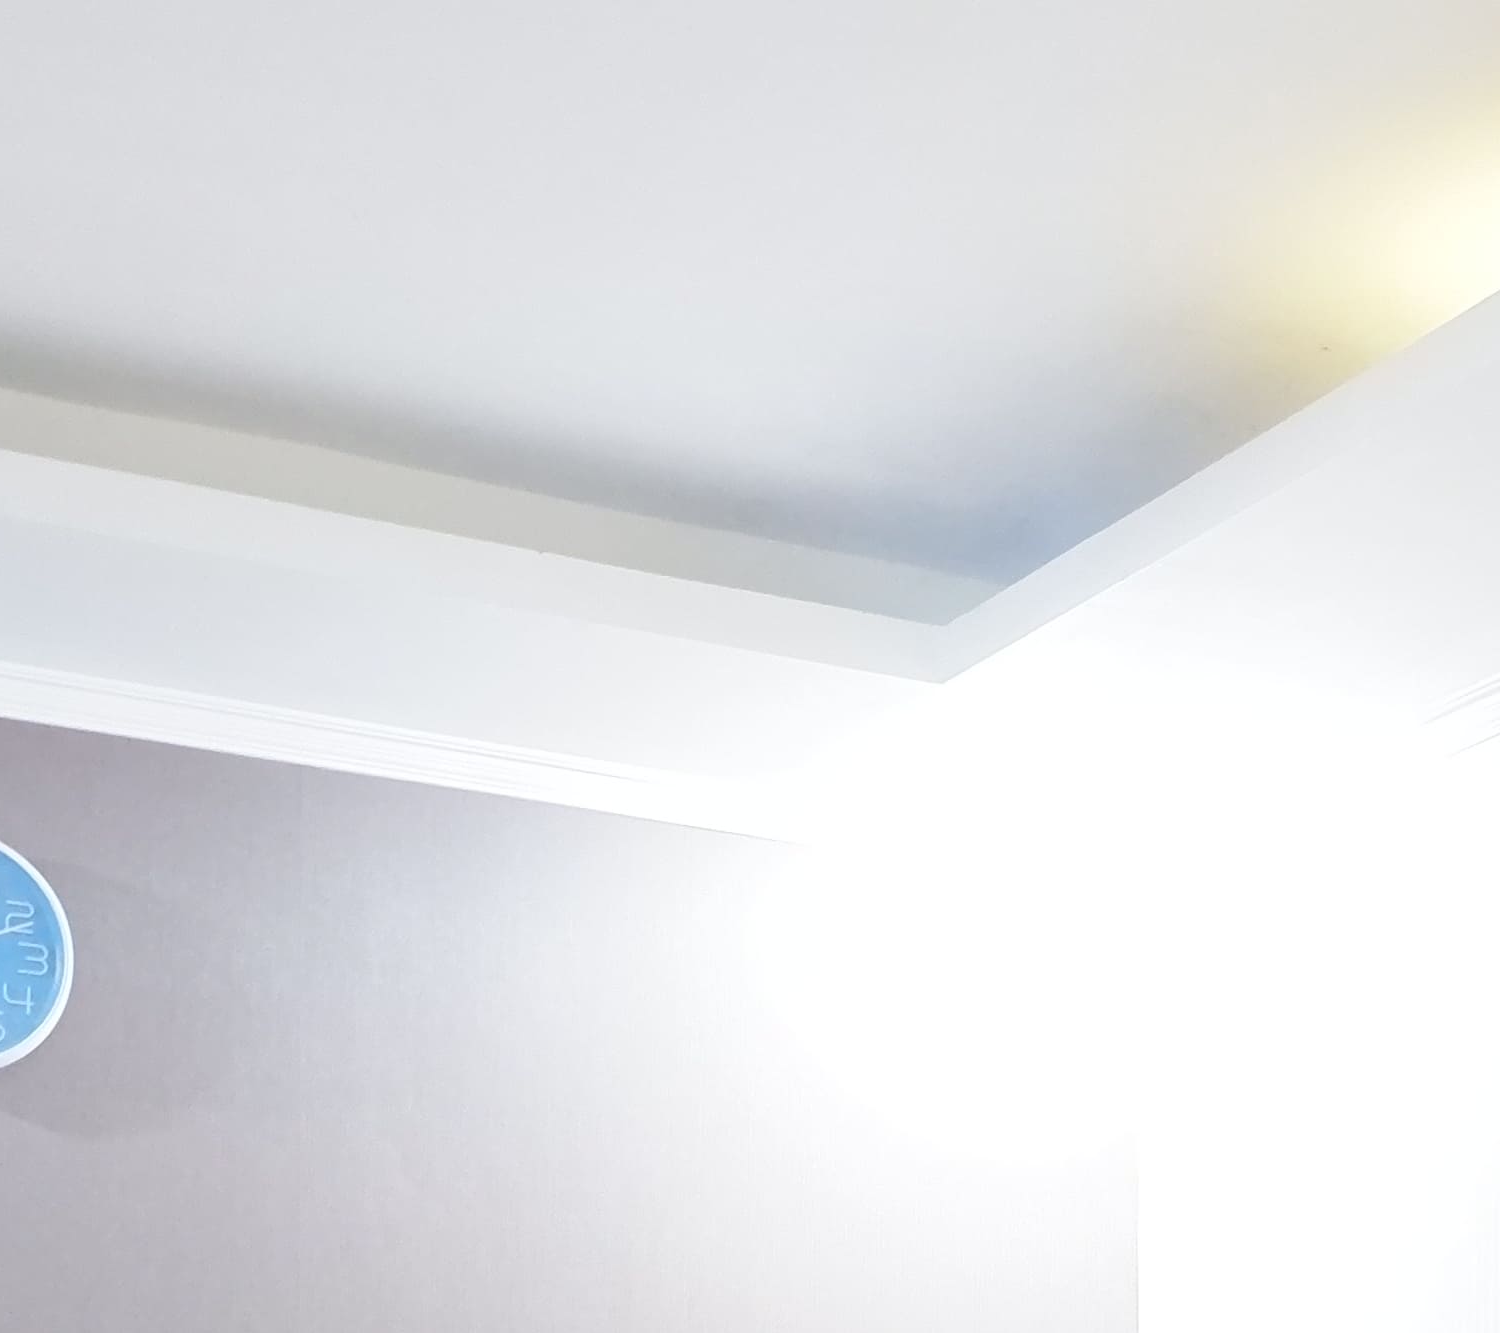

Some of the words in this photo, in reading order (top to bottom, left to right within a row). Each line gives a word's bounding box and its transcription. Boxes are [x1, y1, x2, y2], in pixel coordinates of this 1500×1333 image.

[5, 900, 35, 934] 2
[17, 941, 49, 976] 3
[3, 982, 35, 1015] 4
